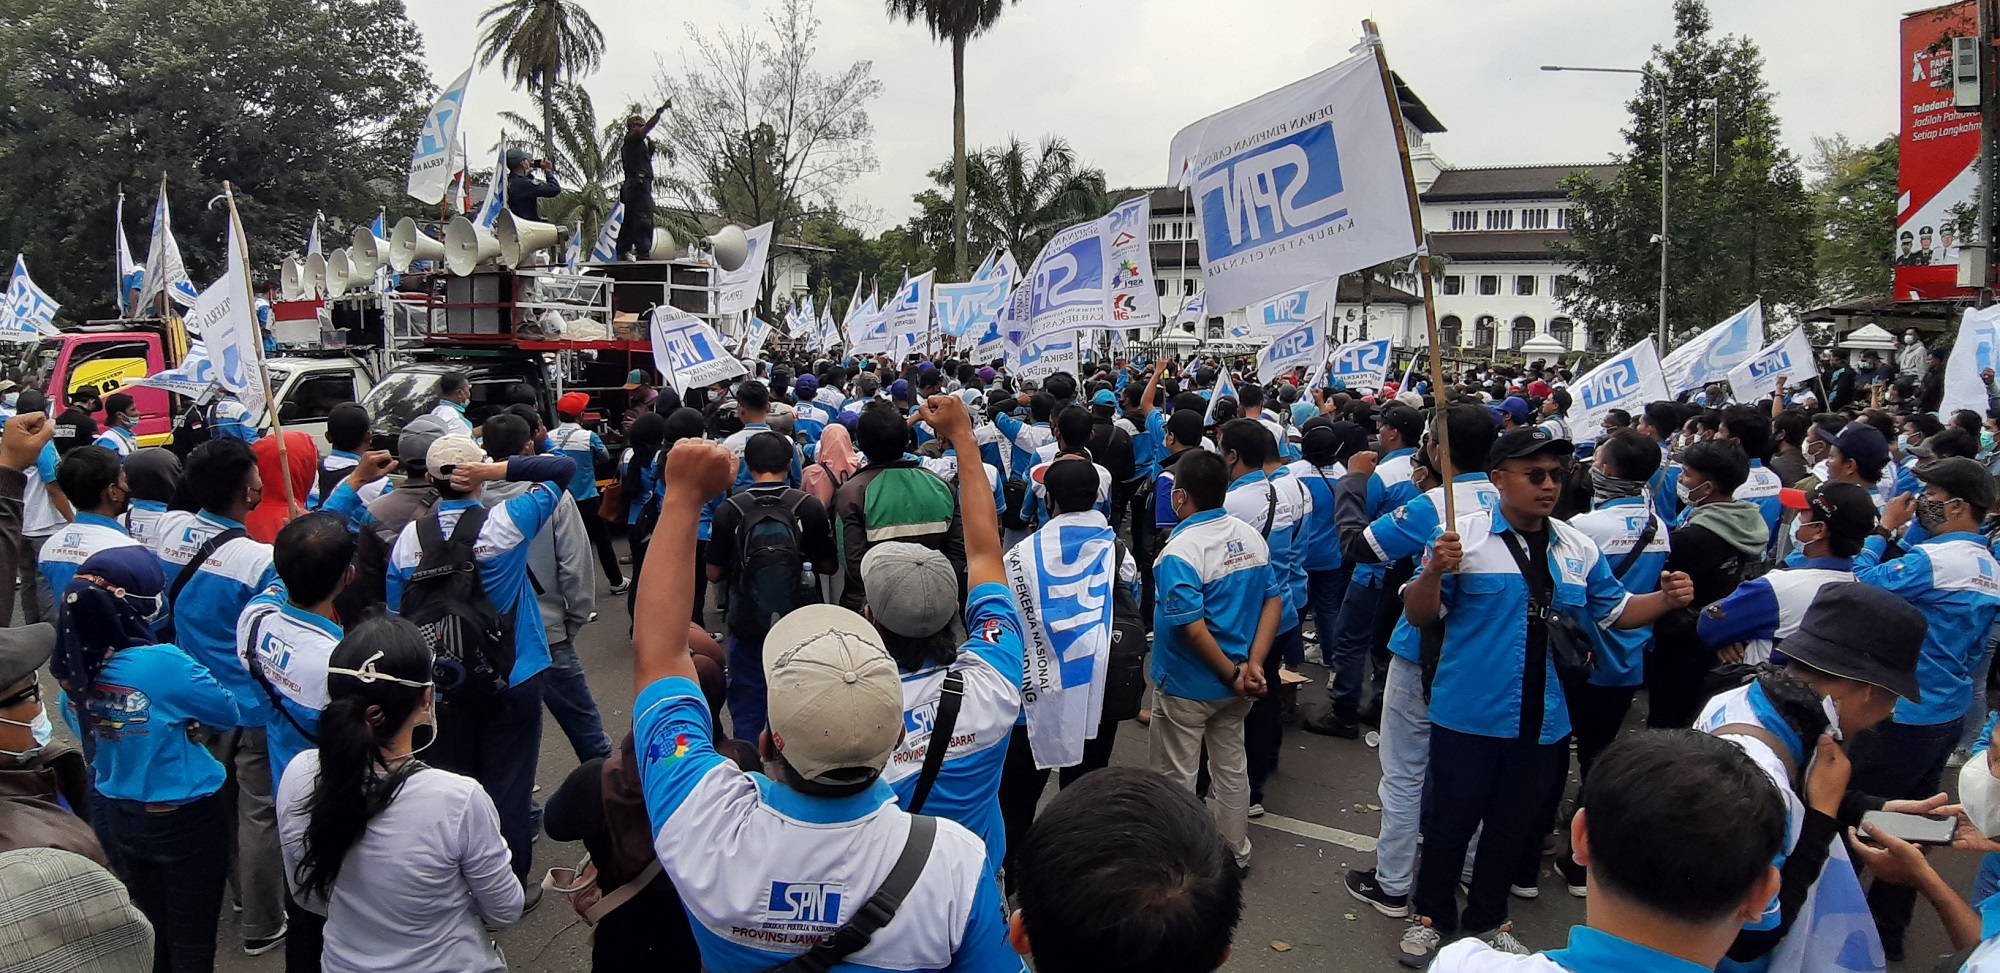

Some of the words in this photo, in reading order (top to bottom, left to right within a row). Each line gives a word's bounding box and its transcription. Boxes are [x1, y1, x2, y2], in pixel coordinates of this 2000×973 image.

[1912, 97, 1948, 114] Teladani
[1912, 112, 1942, 128] Jadilah
[1912, 127, 1938, 142] Setiap
[1749, 351, 1791, 378] SPN
[1034, 525, 1115, 690] SPN
[1014, 576, 1037, 630] PEKERJA
[1032, 631, 1052, 694] NASIONAL
[260, 632, 294, 670] SPN
[949, 732, 977, 748] BARAT
[767, 882, 844, 924] SPN
[732, 926, 787, 943] PROVINSI
[790, 933, 824, 945] JAWA
